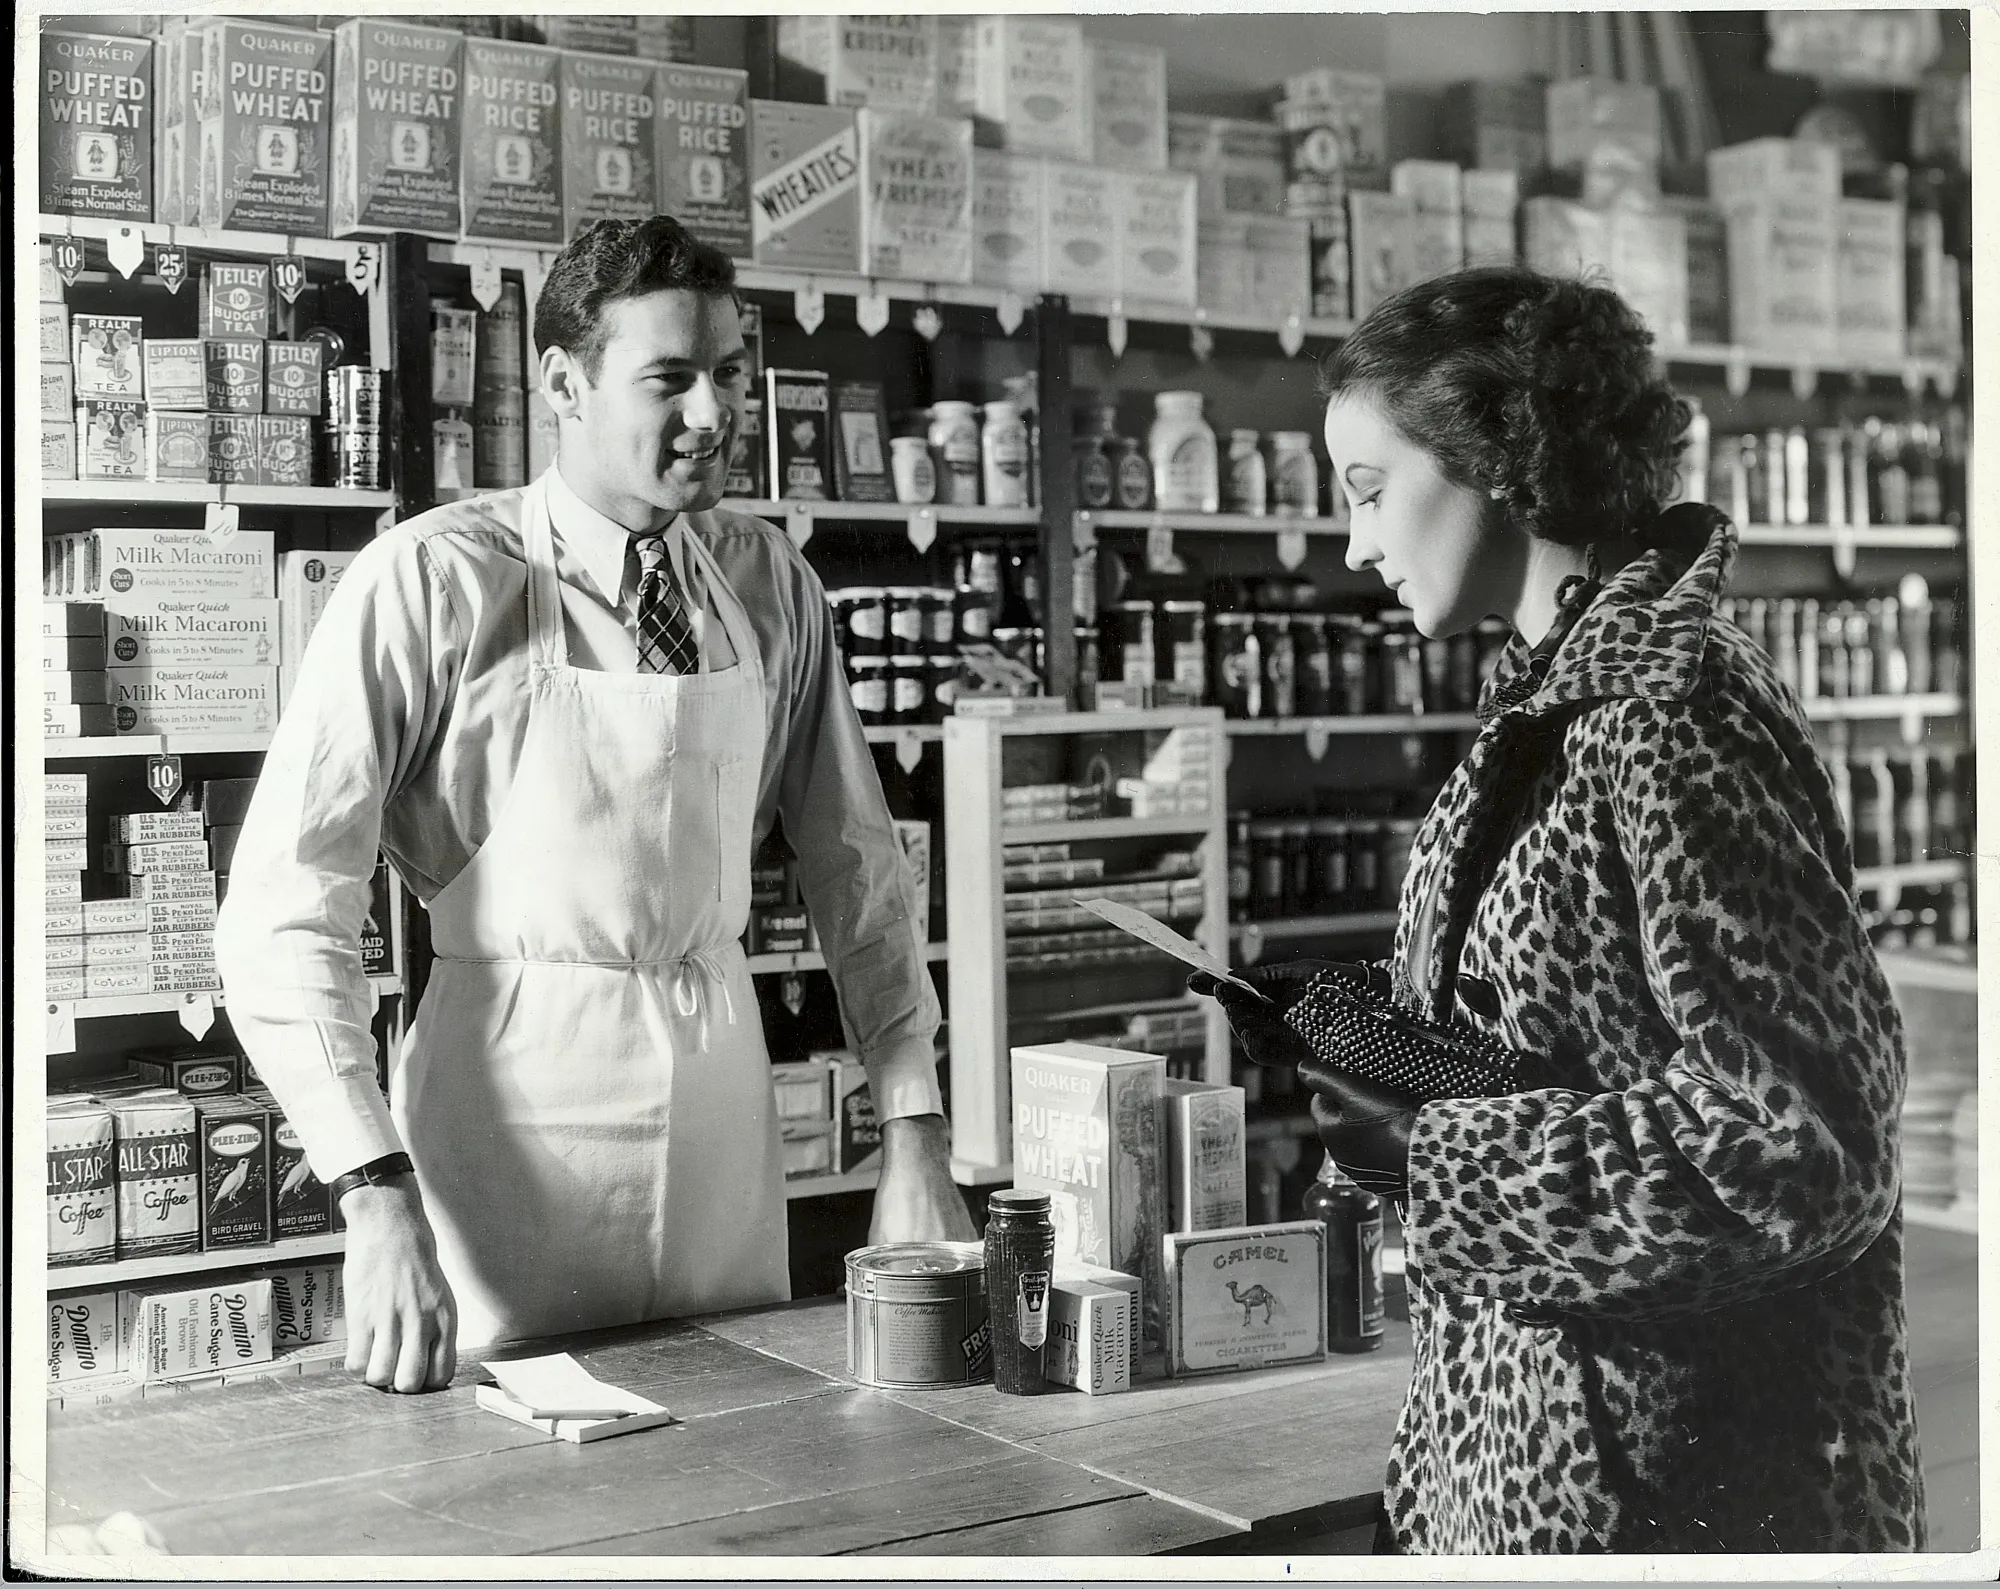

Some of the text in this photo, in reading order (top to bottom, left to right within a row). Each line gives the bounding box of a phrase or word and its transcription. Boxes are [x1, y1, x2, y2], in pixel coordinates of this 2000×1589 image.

[240, 33, 317, 55] QUAKER
[373, 30, 448, 52] QUAKER
[57, 42, 135, 62] QUAKER
[474, 49, 548, 68] QUAKER
[230, 61, 326, 94] PUFFED
[364, 57, 458, 92] PUFFED
[47, 70, 146, 101] PUFFED
[466, 73, 557, 106] PUFFED
[231, 90, 323, 123] WHEAT
[366, 86, 455, 120] WHEAT
[567, 86, 653, 119] PUFFED
[49, 98, 143, 128] WHEAT
[485, 103, 541, 132] RICE
[662, 98, 747, 129] PUFFED
[586, 115, 640, 145] RICE
[679, 124, 732, 154] RICE
[51, 181, 142, 200] Steam Exploded
[760, 145, 856, 222] WHEATIES
[86, 197, 125, 210] Normal
[126, 200, 149, 213] Size
[213, 267, 266, 288] TETLEY
[213, 305, 265, 321] BUDGET
[89, 319, 131, 330] REALM
[224, 321, 255, 332] TEA
[151, 346, 198, 357] LIPTON
[207, 343, 260, 363] TETLEY
[268, 345, 320, 366] TETLEY
[93, 382, 128, 392] TEA
[207, 382, 259, 396] BUDGET
[268, 384, 319, 399] BUDGET
[97, 402, 136, 412] REALM
[216, 397, 250, 408] TEA
[278, 398, 308, 410] TEA
[209, 418, 256, 437] TETLEY
[102, 465, 133, 474] TEA
[208, 457, 257, 470] BUDGET
[262, 458, 308, 472] BUDGET
[216, 470, 244, 482] TEA
[270, 471, 299, 483] TEA
[153, 534, 190, 543] Quaker
[116, 547, 262, 565] Milk Macaroni
[140, 578, 165, 587] Cooks
[168, 578, 177, 587] in
[178, 578, 184, 587] 5
[185, 578, 195, 587] to
[203, 578, 239, 587] Minutes
[158, 602, 230, 612] Quaker Quick
[120, 616, 267, 632] Milk Macaroni
[145, 646, 170, 655] Cooks
[172, 646, 182, 654] in
[183, 646, 189, 655] 5
[190, 646, 199, 654] to
[209, 646, 243, 655] Minutes
[156, 671, 228, 681] Quaker Quick
[119, 684, 266, 701] Milk Macaroni
[144, 715, 169, 724] Cooks
[172, 714, 181, 723] in
[182, 714, 188, 724] 5
[189, 714, 198, 723] to
[207, 714, 242, 724] Minutes
[140, 814, 157, 824] U.S.
[140, 831, 201, 840] JAR RUBBERS
[141, 847, 159, 857] U.S.
[141, 863, 204, 873] JAR RUBBERS
[151, 875, 169, 884] U.S.
[172, 890, 214, 899] RUBBERS
[92, 913, 137, 923] LOVELY
[151, 906, 170, 916] U.S.
[172, 922, 215, 930] RUBBERS
[151, 935, 170, 945] U.S.
[92, 945, 137, 955] LOVELY
[152, 951, 215, 961] JAR RUBBERS
[153, 965, 171, 975] U.S.
[93, 976, 138, 987] LOVELY
[173, 981, 216, 990] RUBBERS
[184, 1071, 229, 1084] PLEE-ZING
[1025, 1066, 1091, 1095] QUAKER
[1018, 1103, 1102, 1150] PUFFED
[212, 1133, 259, 1146] PLEE-ZING
[118, 1143, 189, 1172] ALL STAR
[1020, 1141, 1101, 1188] WHEAT
[64, 1157, 104, 1184] STAR
[143, 1188, 189, 1221] Coffee
[59, 1202, 104, 1235] Coffee
[278, 1213, 326, 1226] BIRD GRAVEL
[212, 1222, 262, 1235] BIRD GRAVEL
[1213, 1246, 1289, 1269] CAMEL
[271, 1276, 298, 1340] Domino
[300, 1270, 317, 1341] Cane Sugar
[323, 1269, 335, 1336] Old Fashioned
[334, 1286, 343, 1319] Brown
[895, 1307, 917, 1318] Coffee
[178, 1317, 188, 1351] Brown
[188, 1298, 199, 1369] Old Fashioned
[207, 1293, 223, 1366] Cane Sugar
[224, 1294, 255, 1358] Domino
[1129, 1290, 1139, 1367] Macaroni
[48, 1305, 64, 1379] Cane Sugar
[65, 1305, 98, 1370] Domino
[153, 1303, 161, 1374] Refining Company
[160, 1306, 168, 1370] American Sugar
[1104, 1327, 1114, 1364] Milk
[1114, 1305, 1124, 1384] Macaroni
[1093, 1306, 1104, 1389] Quaker Quick
[1216, 1342, 1287, 1358] CIGARETTES
